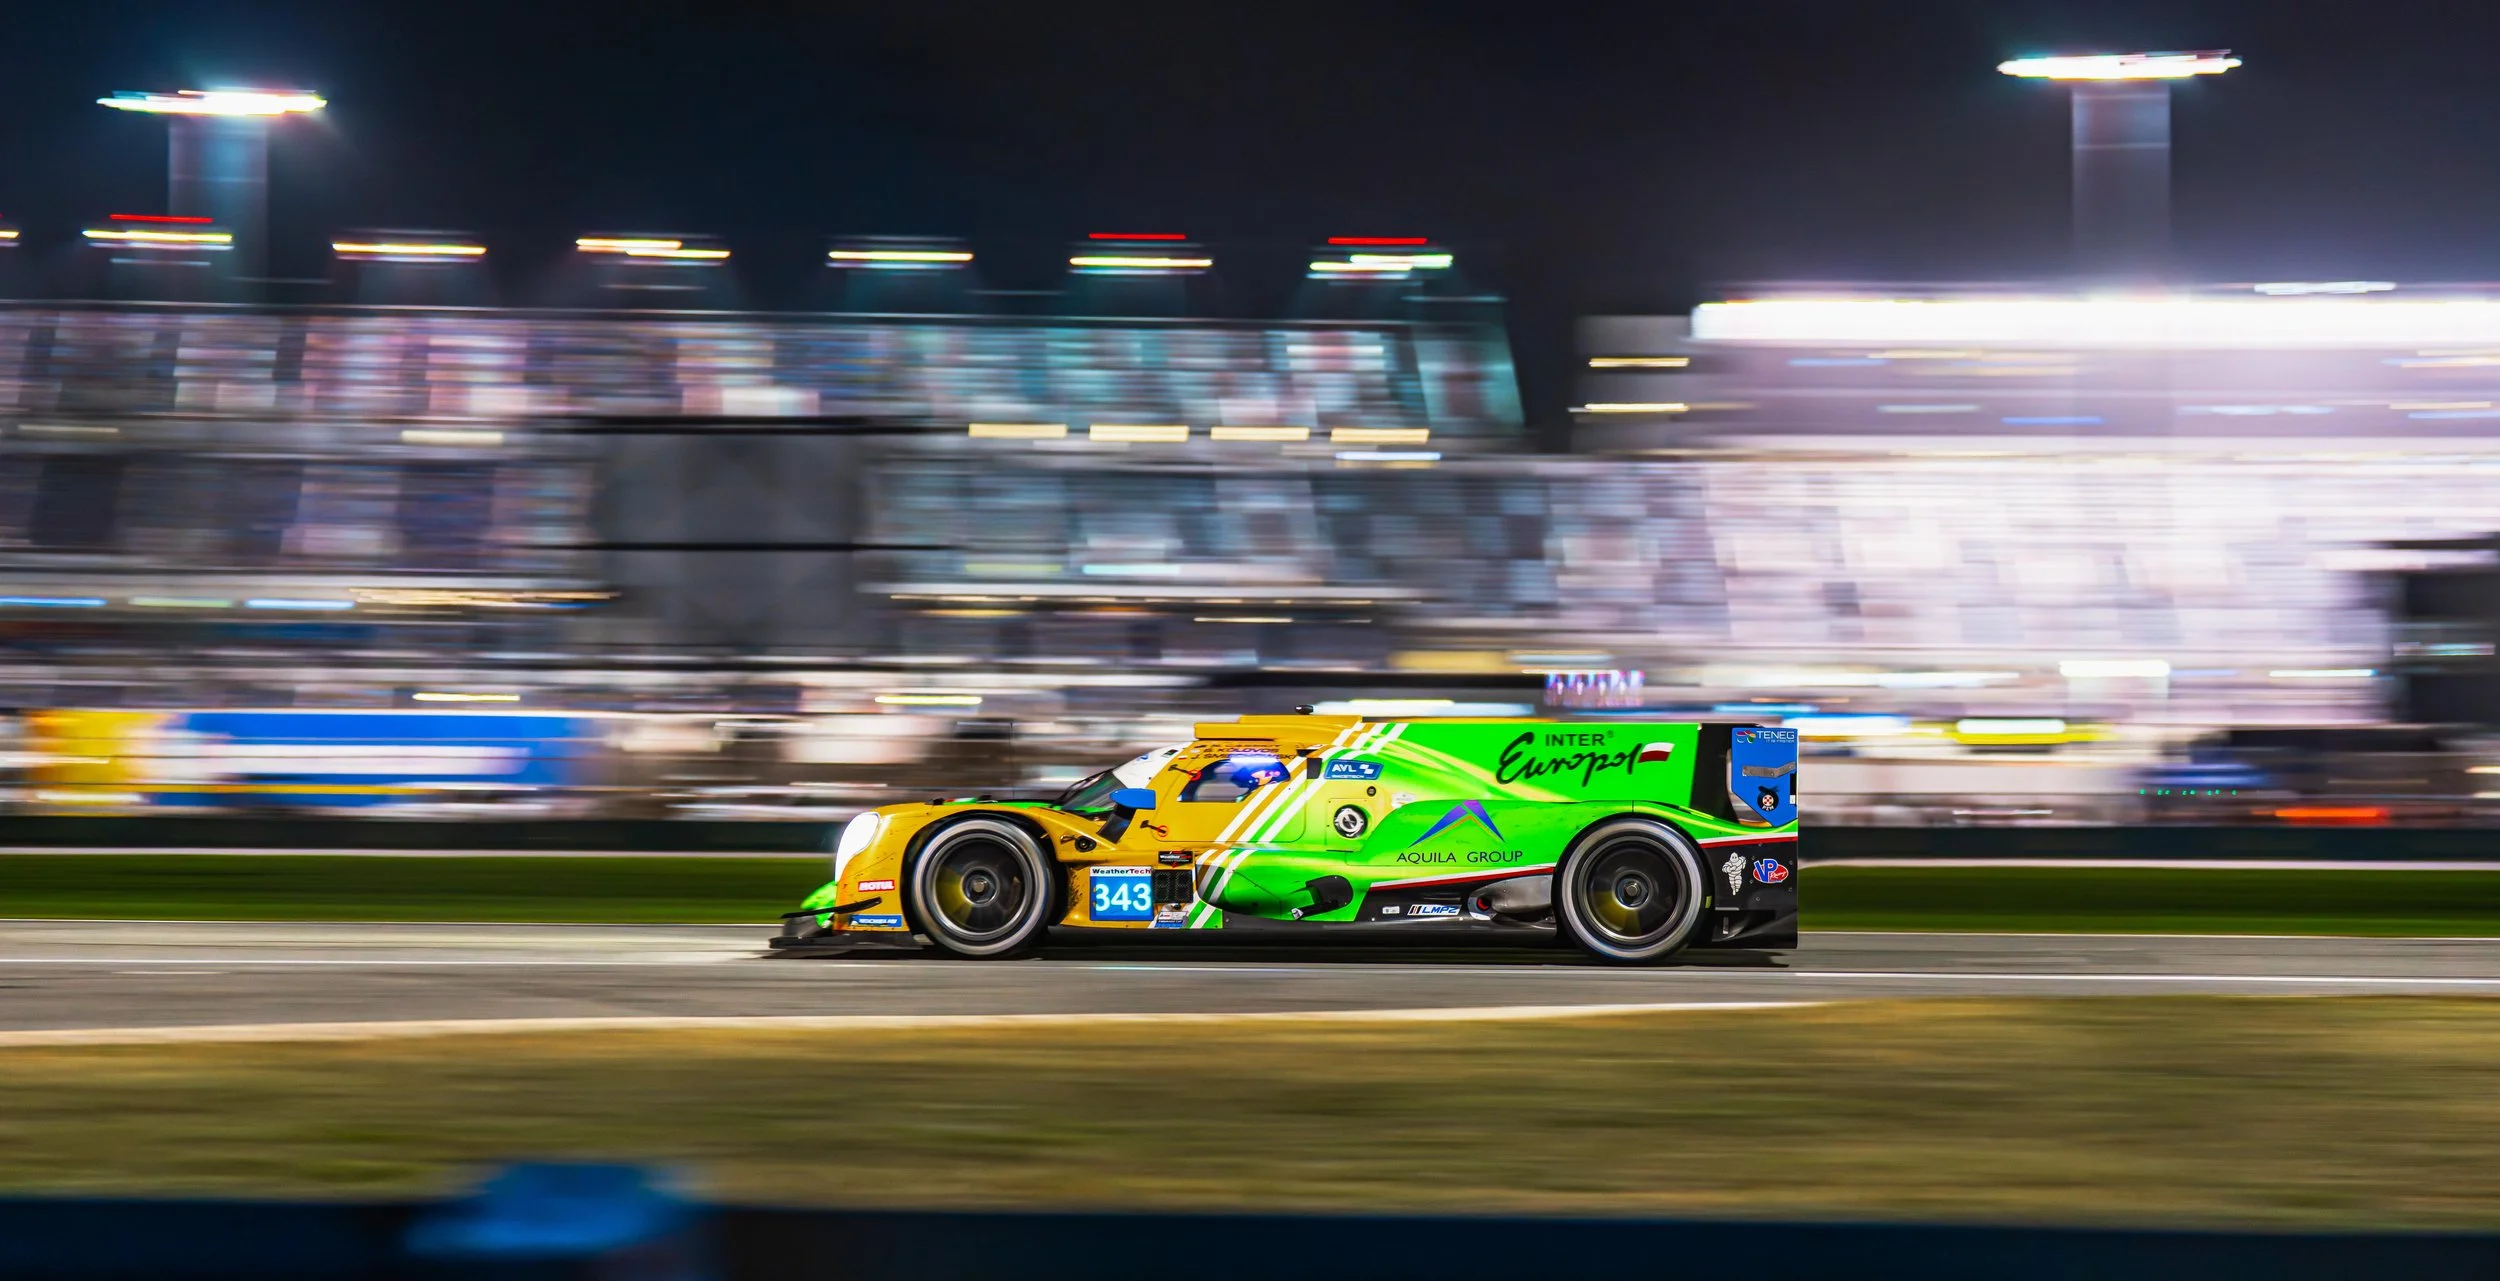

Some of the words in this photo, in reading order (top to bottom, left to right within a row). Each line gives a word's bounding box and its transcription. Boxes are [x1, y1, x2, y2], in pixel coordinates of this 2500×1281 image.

[1545, 733, 1605, 747] INTER
[1756, 730, 1795, 739] TENEG
[1496, 731, 1644, 788] Europol
[1331, 764, 1357, 773] AVL
[1396, 852, 1457, 864] AQUILA
[1466, 850, 1523, 863] GROUP
[1753, 858, 1778, 883] VP
[858, 881, 895, 891] MOTUL
[1093, 883, 1152, 912] 343
[1422, 905, 1459, 914] LMP2
